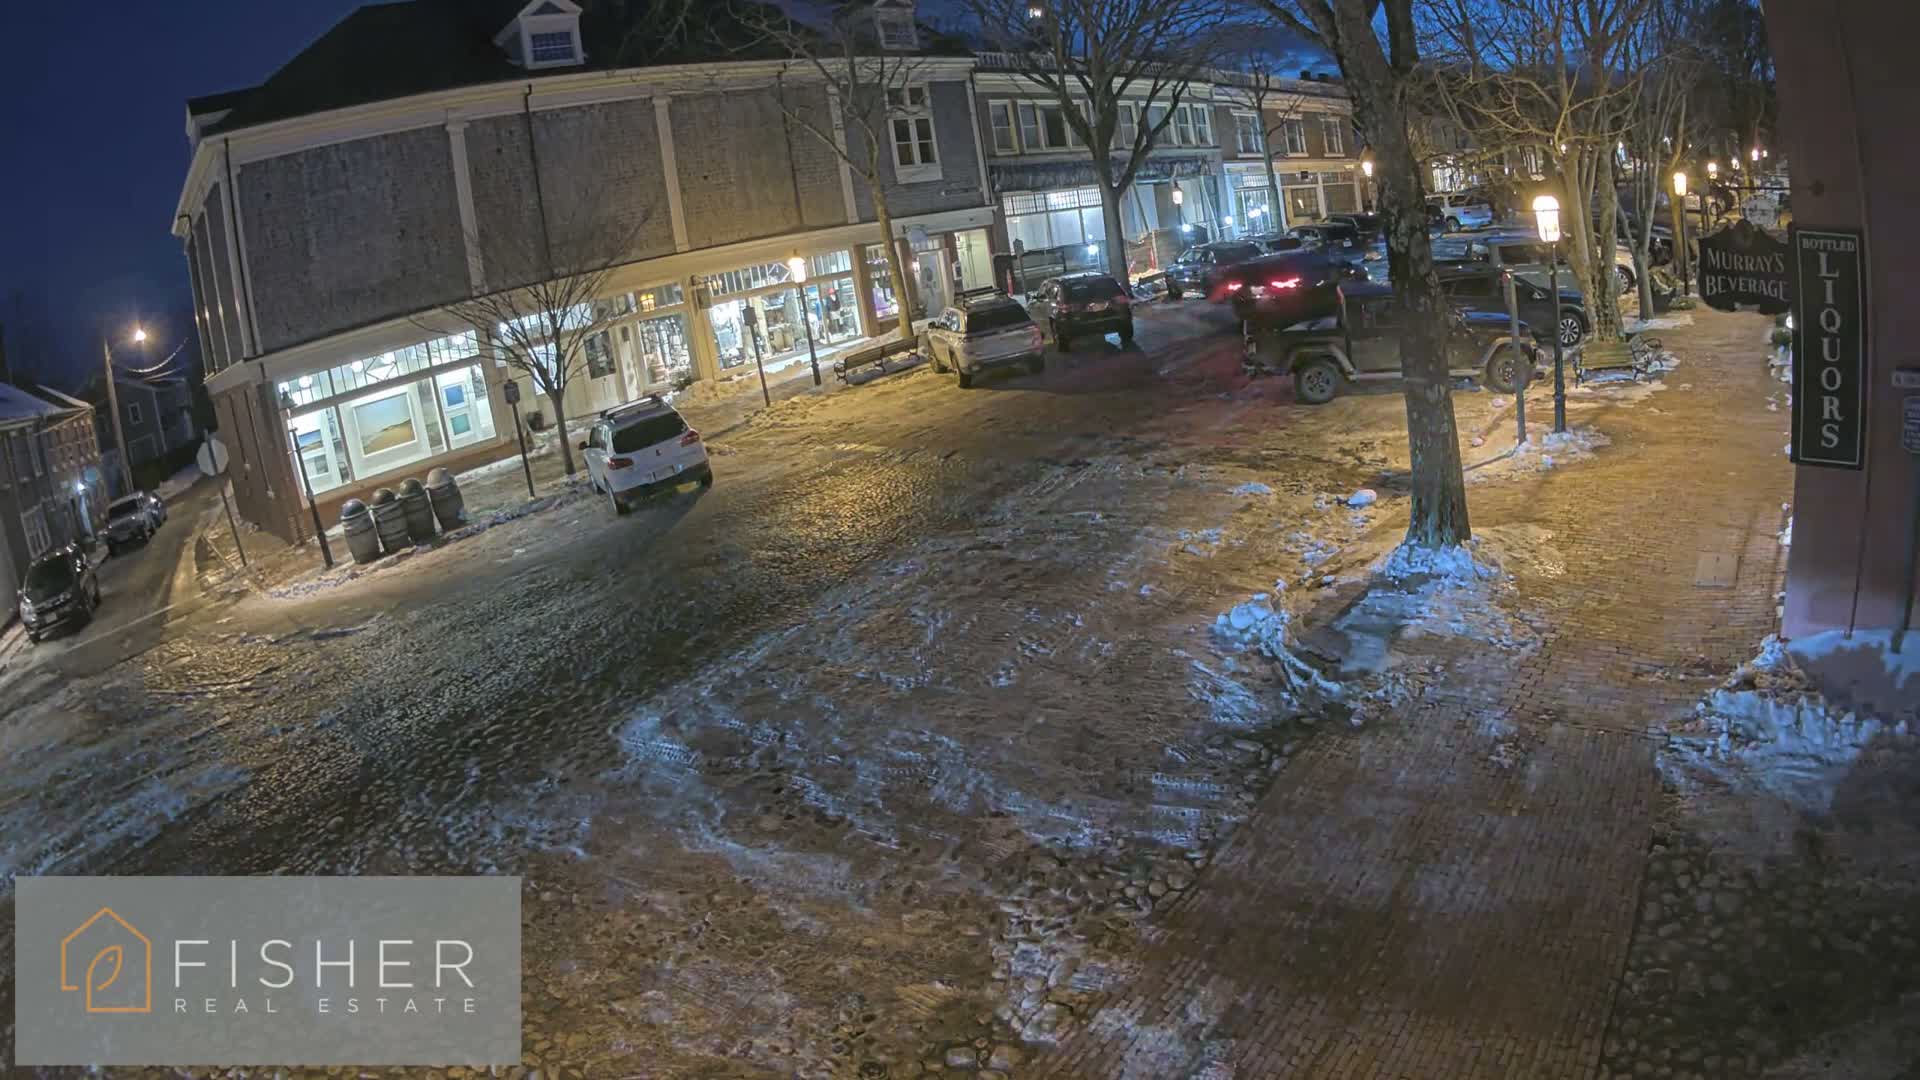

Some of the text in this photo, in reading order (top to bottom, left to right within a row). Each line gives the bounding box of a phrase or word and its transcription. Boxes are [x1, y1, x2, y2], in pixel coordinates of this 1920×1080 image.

[1802, 238, 1855, 252] BOTTLED
[1706, 275, 1790, 302] BEVERAGE
[1819, 252, 1844, 448] LIQUORS
